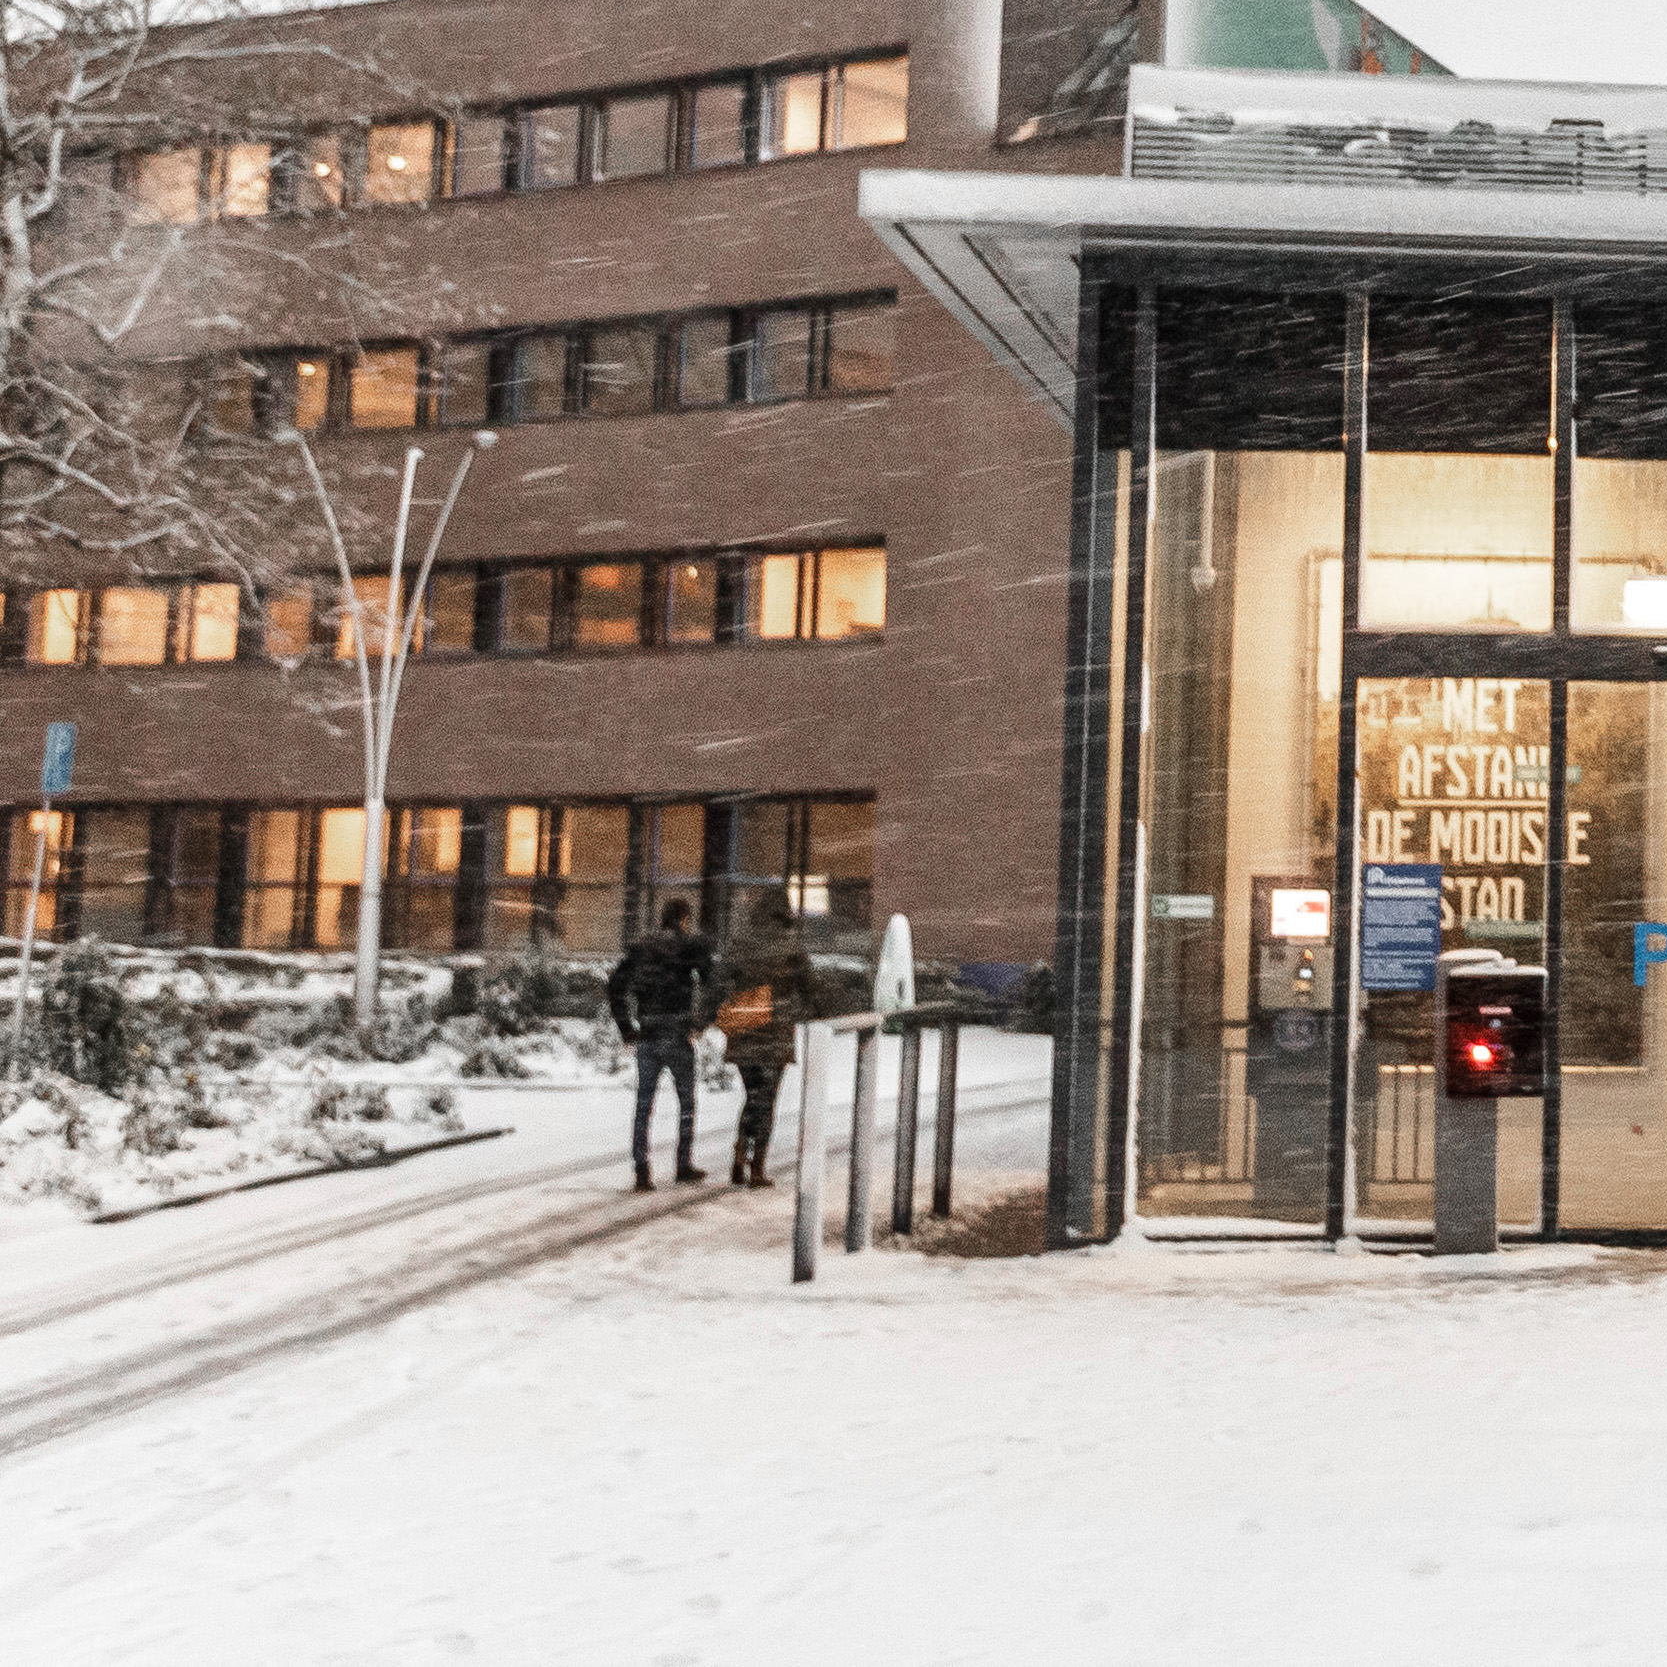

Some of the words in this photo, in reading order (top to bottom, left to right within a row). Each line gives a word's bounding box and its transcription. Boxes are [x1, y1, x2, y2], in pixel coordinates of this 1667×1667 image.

[1443, 678, 1523, 732] MET
[1367, 810, 1416, 864] DE
[1430, 810, 1592, 865] MOOISE
